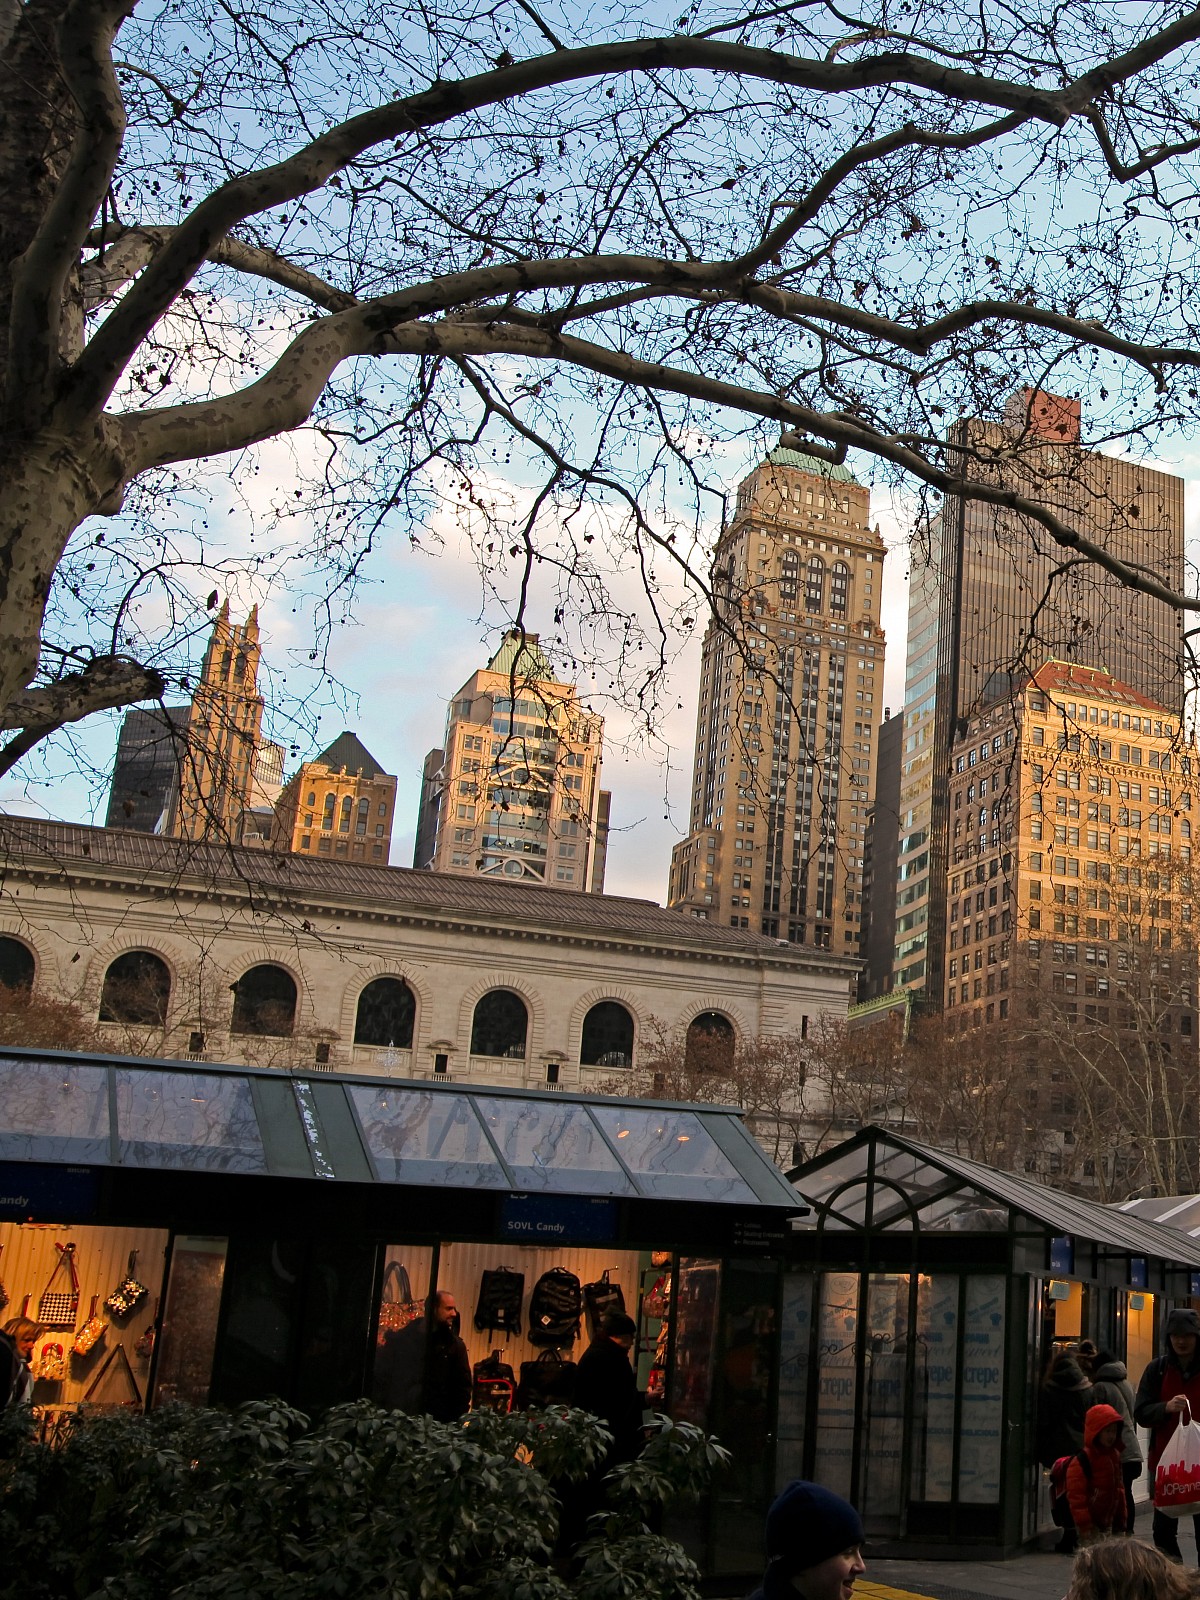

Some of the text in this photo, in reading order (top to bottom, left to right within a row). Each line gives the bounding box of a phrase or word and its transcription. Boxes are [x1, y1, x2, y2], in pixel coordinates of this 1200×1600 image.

[0, 1195, 30, 1208] andy
[507, 1221, 565, 1234] SOVL Candy
[965, 1367, 999, 1388] crepe
[820, 1377, 852, 1401] crepe
